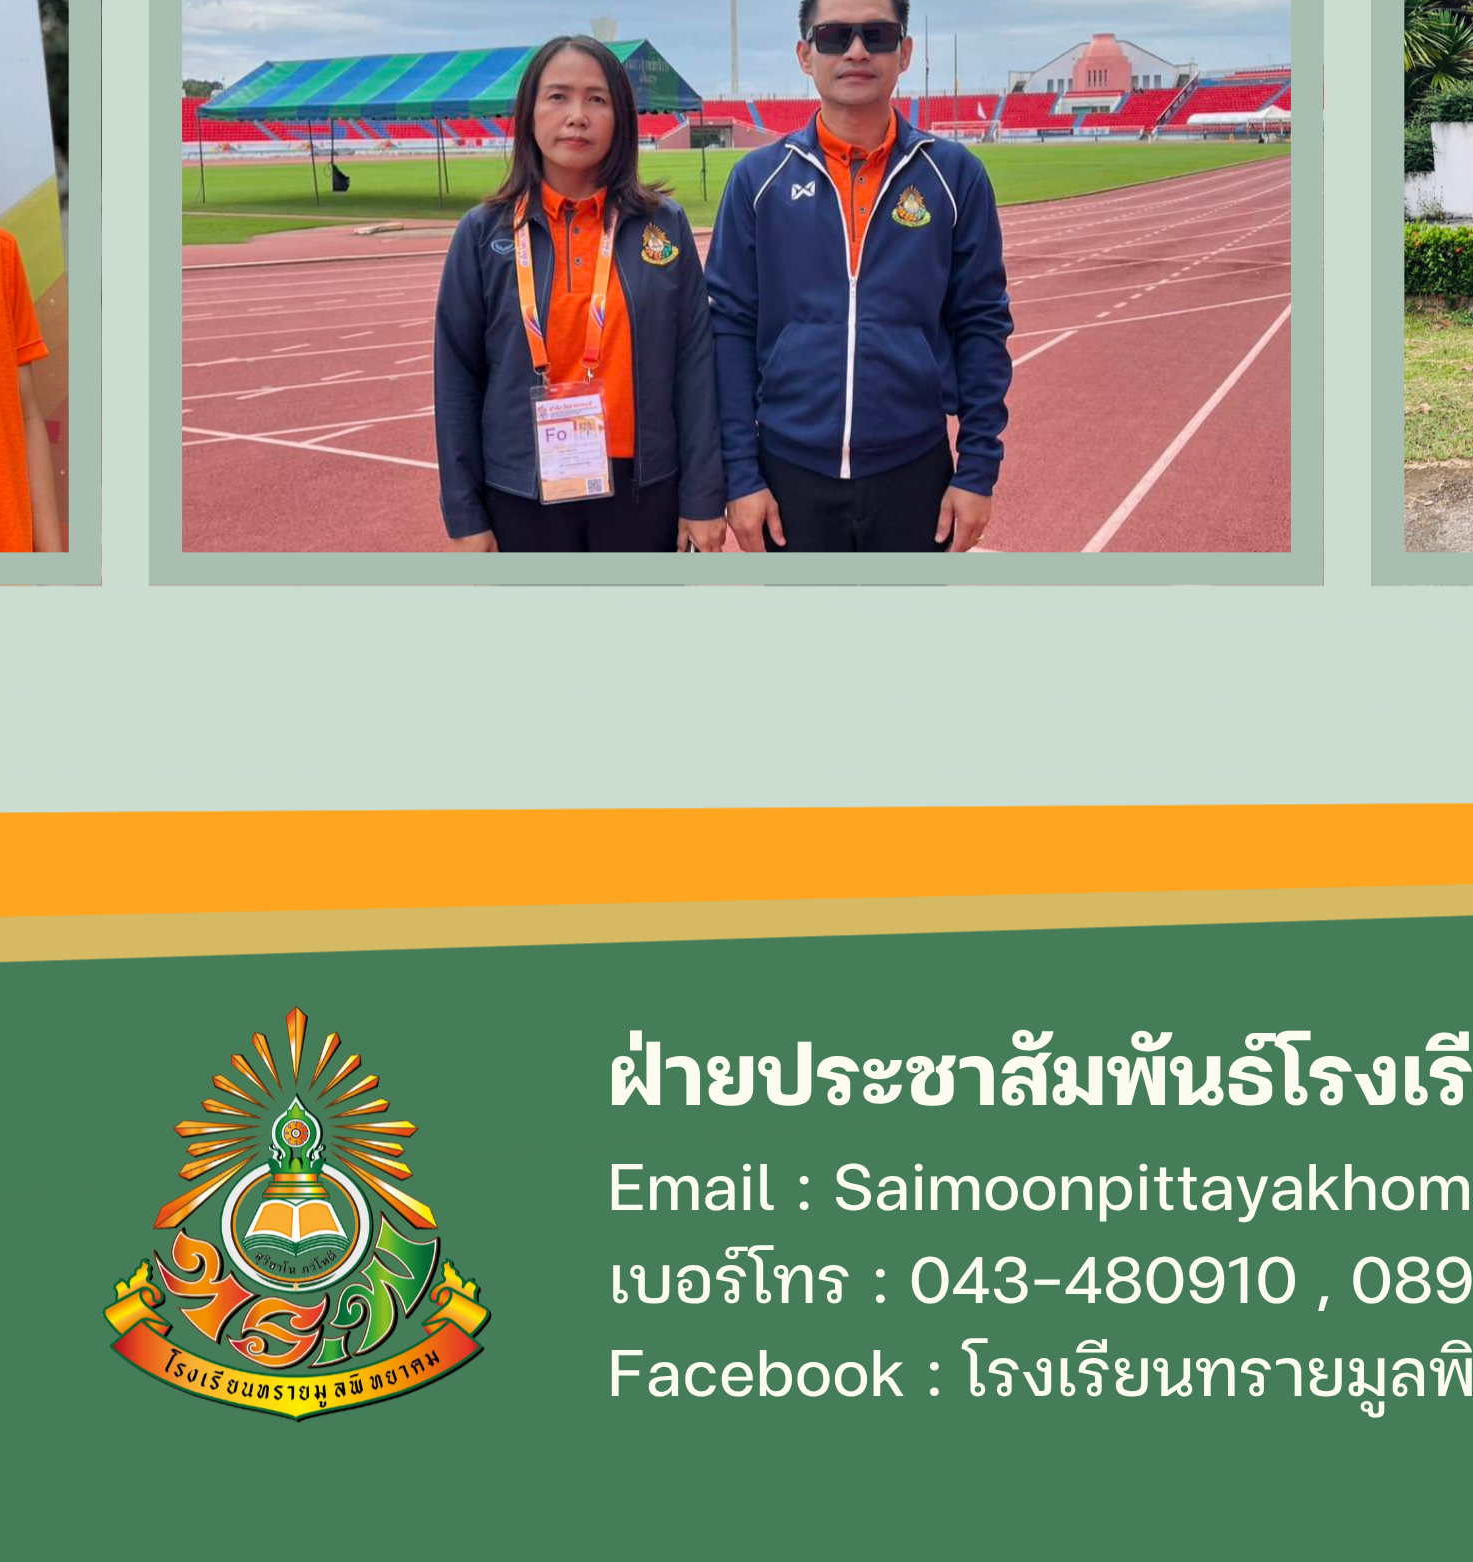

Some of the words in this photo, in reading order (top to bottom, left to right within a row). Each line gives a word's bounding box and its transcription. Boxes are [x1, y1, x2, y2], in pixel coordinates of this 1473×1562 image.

[544, 427, 568, 443] Fo
[611, 1163, 775, 1211] Email
[799, 1175, 809, 1211] :
[612, 1244, 849, 1304] เบอร์โทร
[875, 1268, 886, 1304] :
[911, 1256, 1296, 1304] 043-480910
[163, 1347, 441, 1408] โรงเรียนทรายมูลพิทยาคม
[611, 1349, 904, 1397] Facebook
[929, 1361, 940, 1397] :
